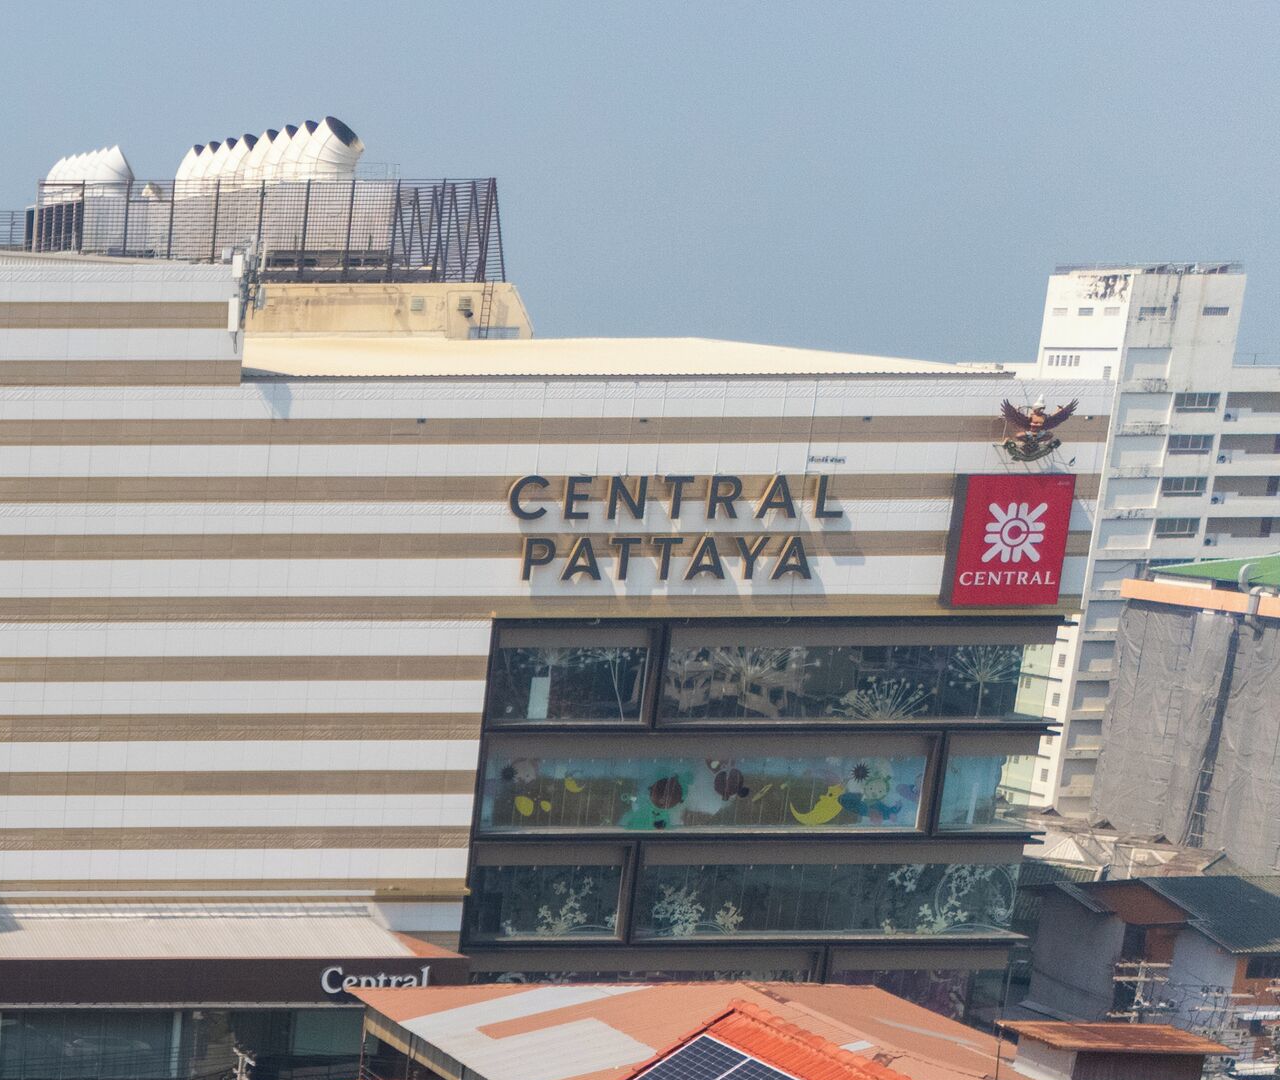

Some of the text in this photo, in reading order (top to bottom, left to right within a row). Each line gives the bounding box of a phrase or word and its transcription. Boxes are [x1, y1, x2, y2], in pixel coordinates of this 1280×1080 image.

[508, 474, 844, 520] CENTRAL
[521, 536, 813, 582] PATTAYA
[959, 570, 1057, 587] CENTRAL
[321, 966, 430, 994] Central
